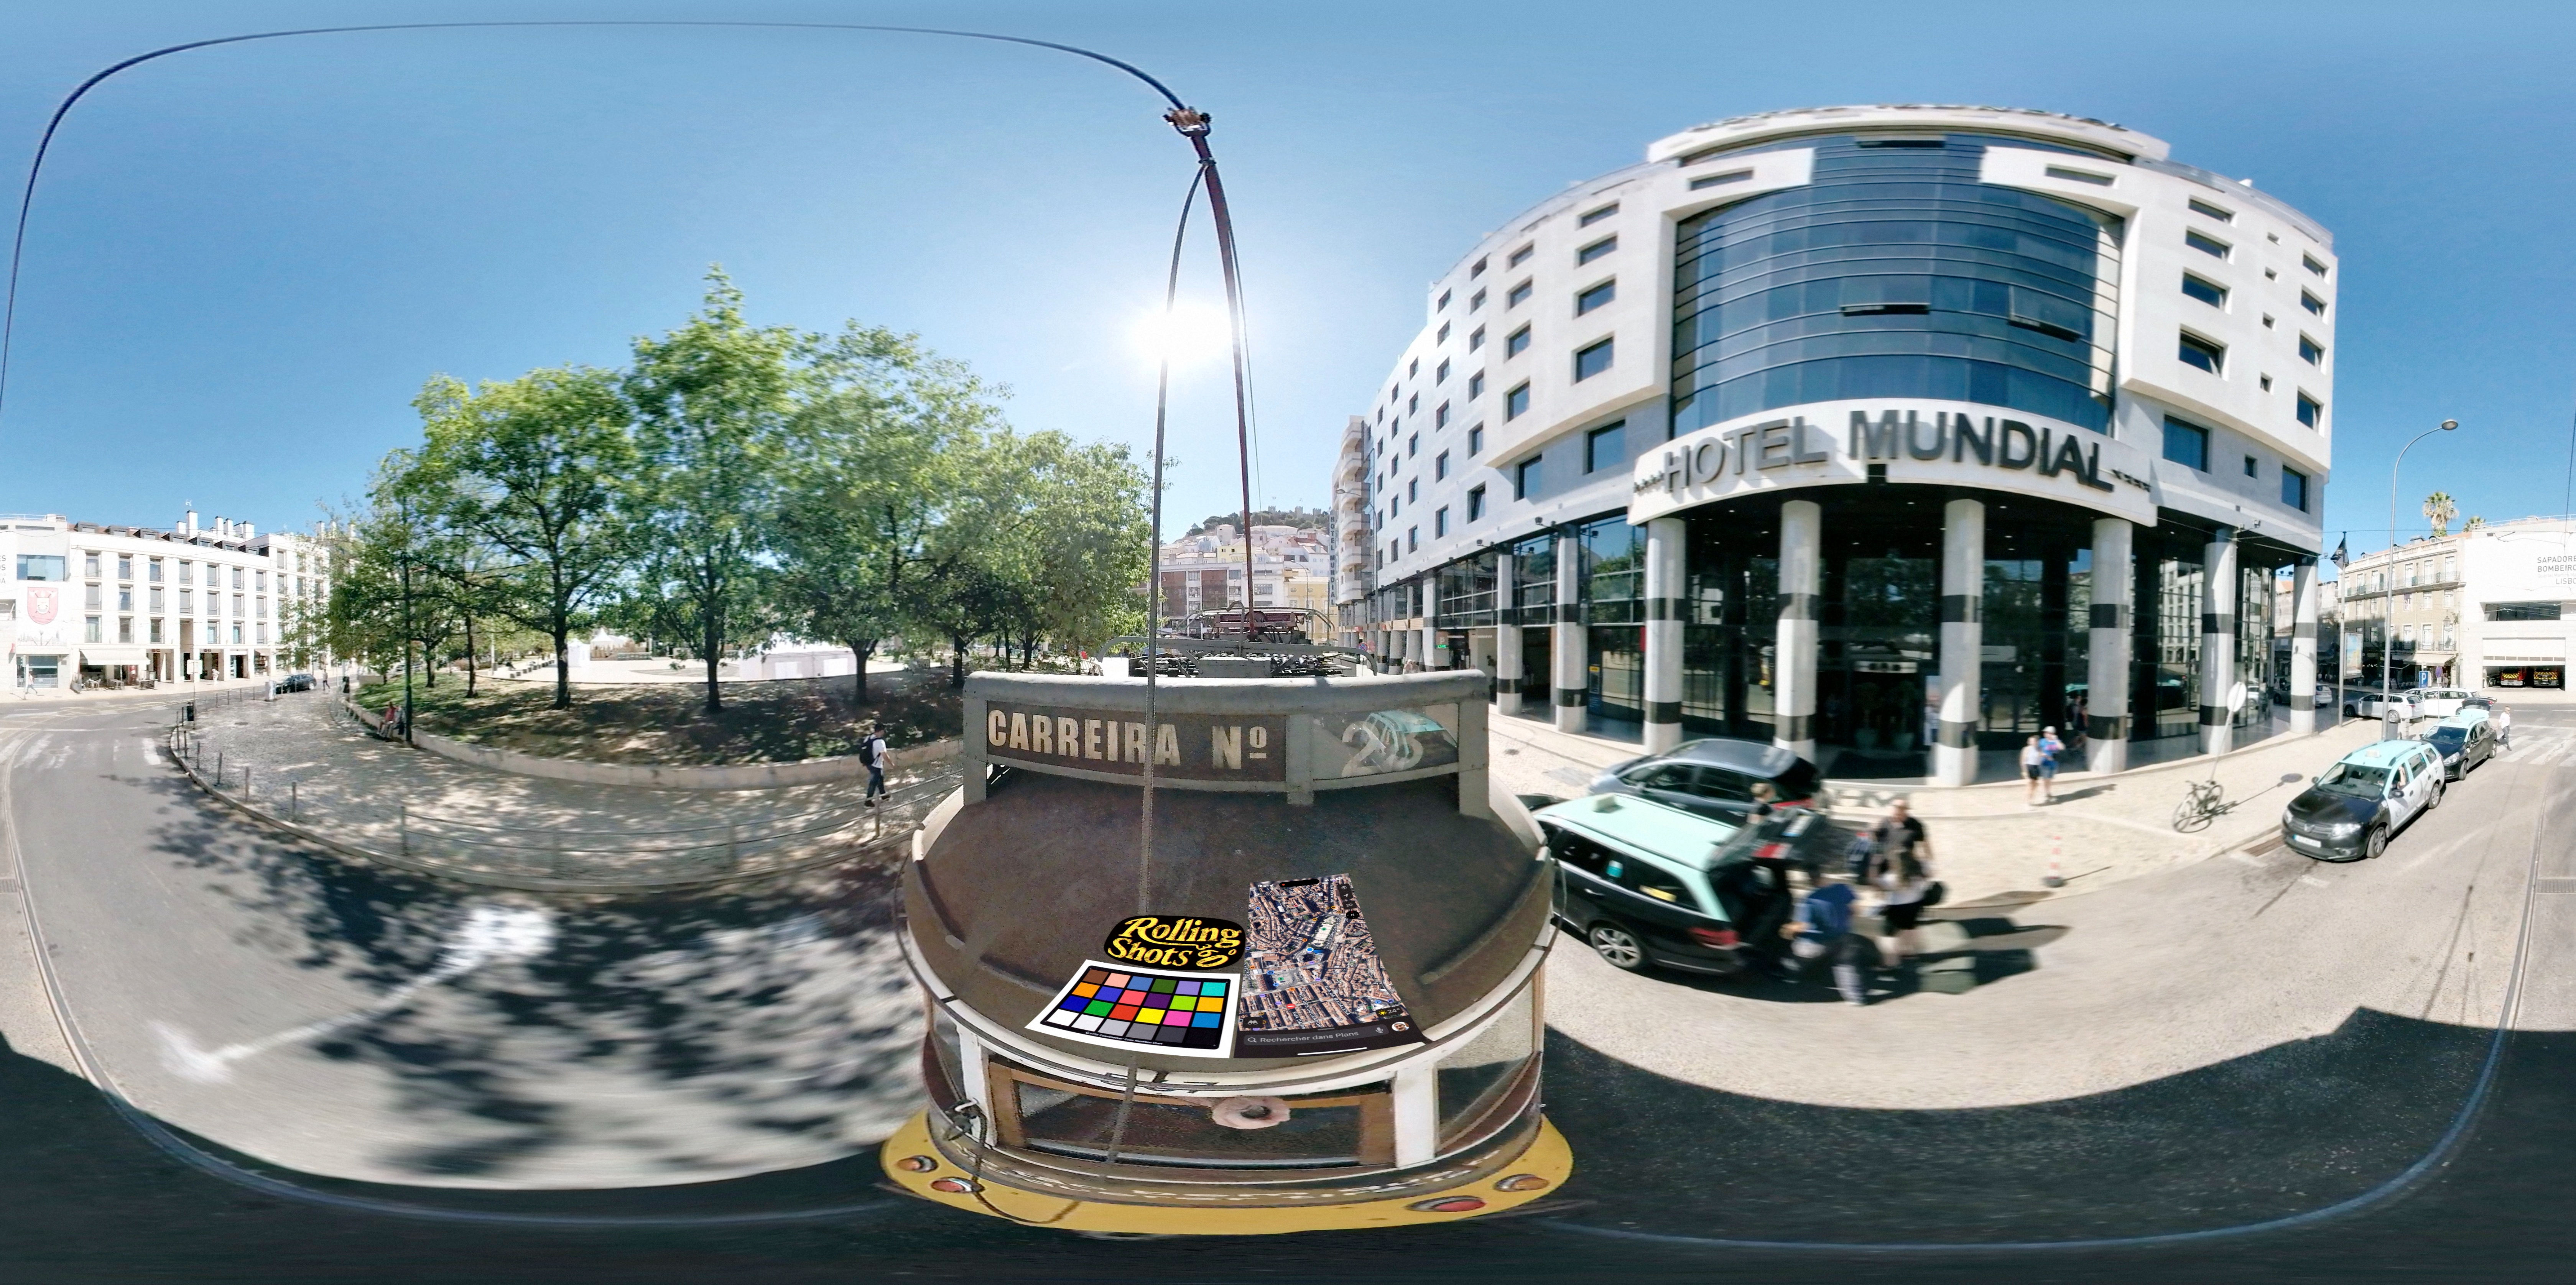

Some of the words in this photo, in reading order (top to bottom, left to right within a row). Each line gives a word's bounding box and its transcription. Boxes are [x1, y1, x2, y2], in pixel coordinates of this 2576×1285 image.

[1664, 416, 1828, 493] HOTEL
[1849, 409, 2114, 493] MUNDIAL
[2421, 672, 2426, 684] P
[988, 710, 1181, 766] CARREIRA
